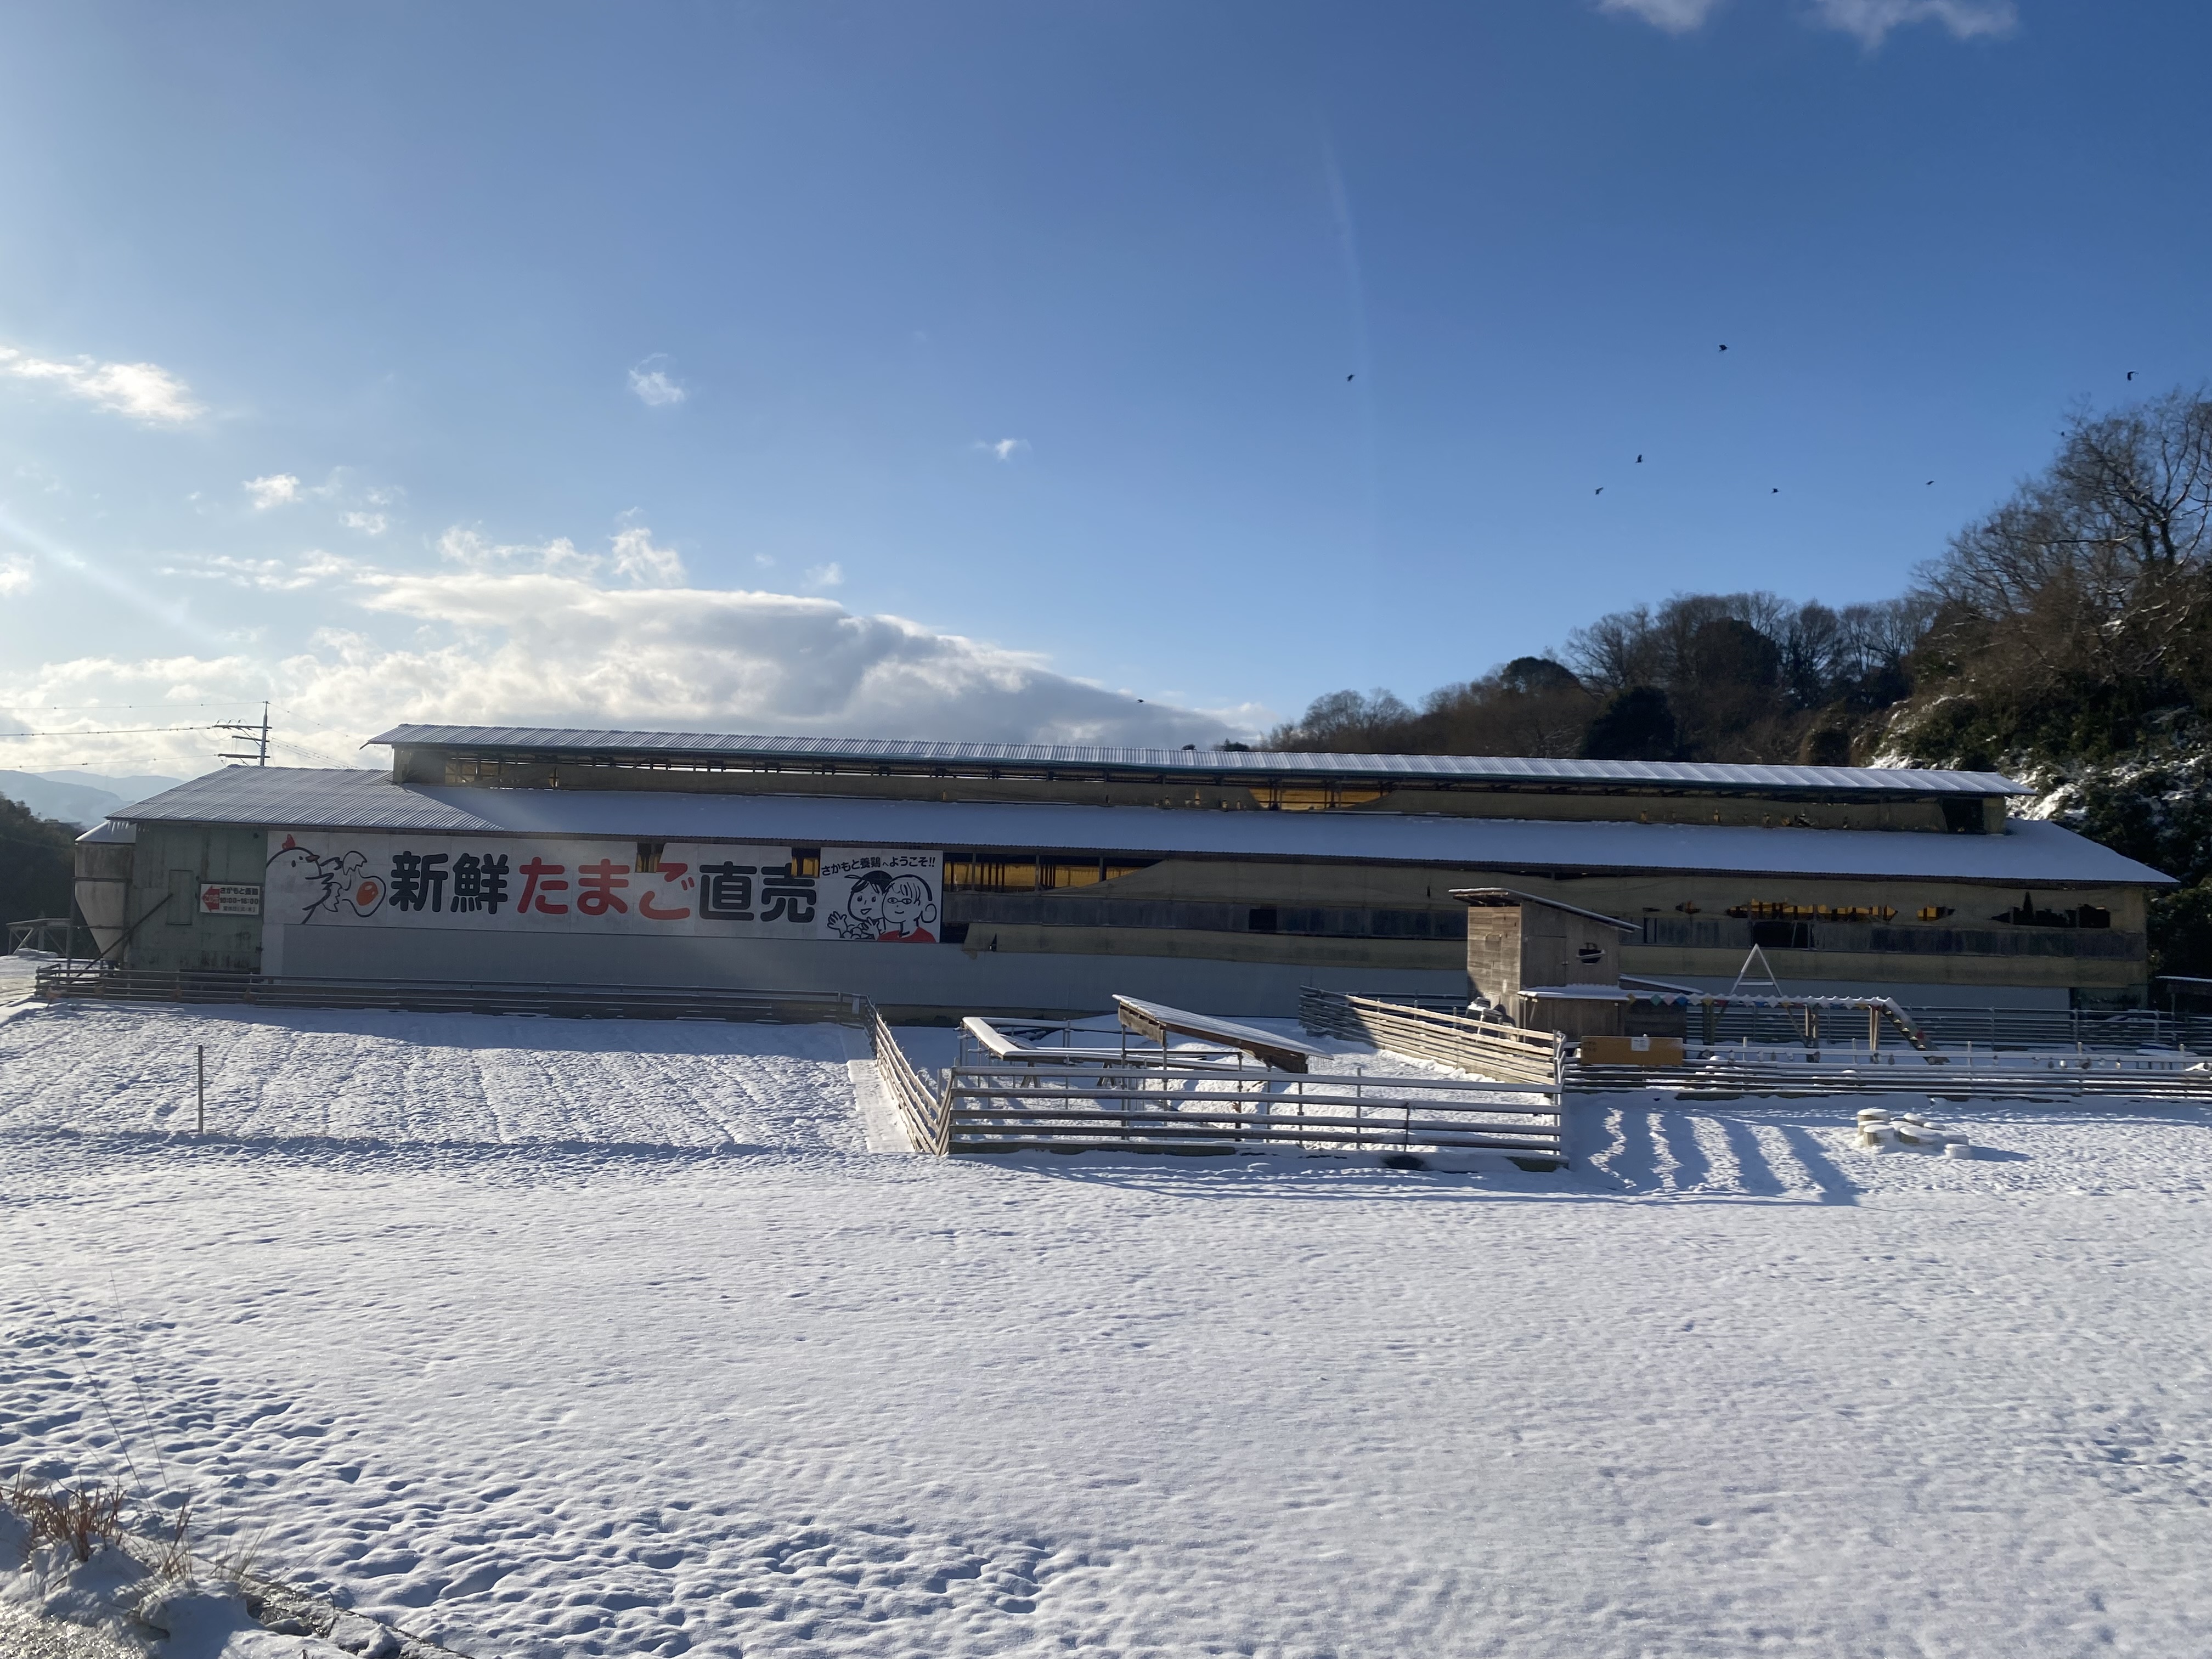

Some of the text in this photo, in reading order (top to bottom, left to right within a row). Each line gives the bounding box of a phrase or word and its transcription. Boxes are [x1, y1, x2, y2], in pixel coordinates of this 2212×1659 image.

[389, 851, 817, 923] 新鮮たまご直売
